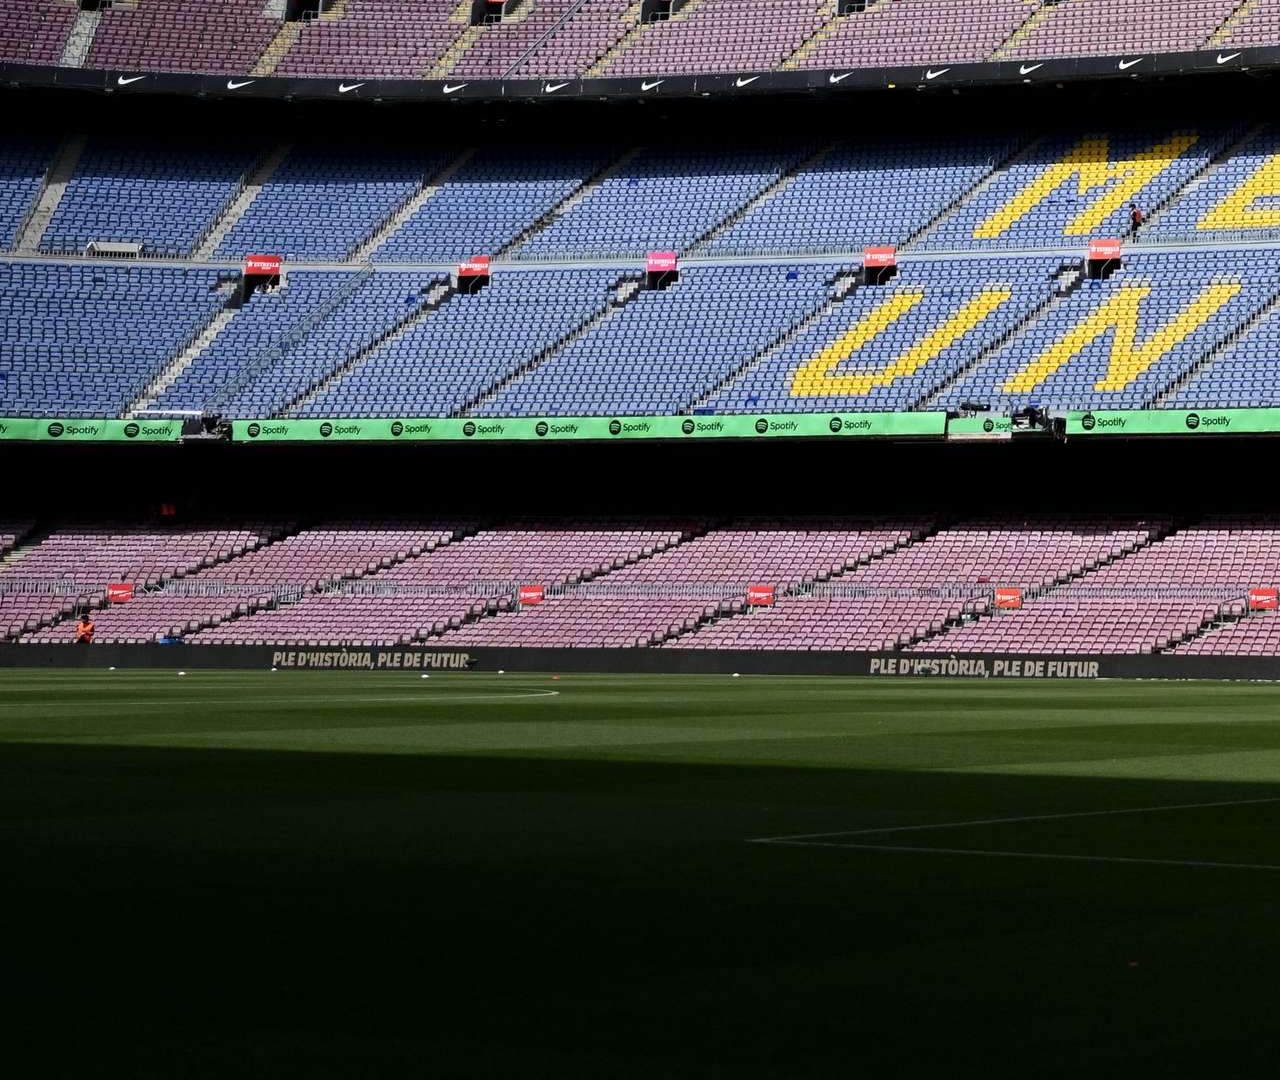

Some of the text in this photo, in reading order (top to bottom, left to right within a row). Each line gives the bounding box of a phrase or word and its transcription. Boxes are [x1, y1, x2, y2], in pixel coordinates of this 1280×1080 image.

[790, 278, 1242, 395] UN
[697, 421, 724, 432] Spotify
[770, 421, 799, 432] Spotify
[845, 419, 873, 430] Spotify
[1098, 417, 1127, 428] Spotify
[1202, 416, 1231, 427] Spotify
[66, 424, 98, 437] Spotify
[142, 425, 174, 438] Spotify
[262, 425, 289, 436] Spotify
[335, 425, 362, 436] Spotify
[405, 423, 433, 435] Spotify
[478, 423, 505, 435] Spotify
[551, 423, 579, 435] Spotify
[623, 422, 651, 433] Spotify
[272, 648, 470, 669] PLE D'HISTÒRIA, PLE DE FUTUR
[870, 658, 897, 674] PLE
[993, 659, 1022, 676] PLE
[1024, 660, 1044, 677] DE
[1047, 661, 1099, 678] FUTUR
